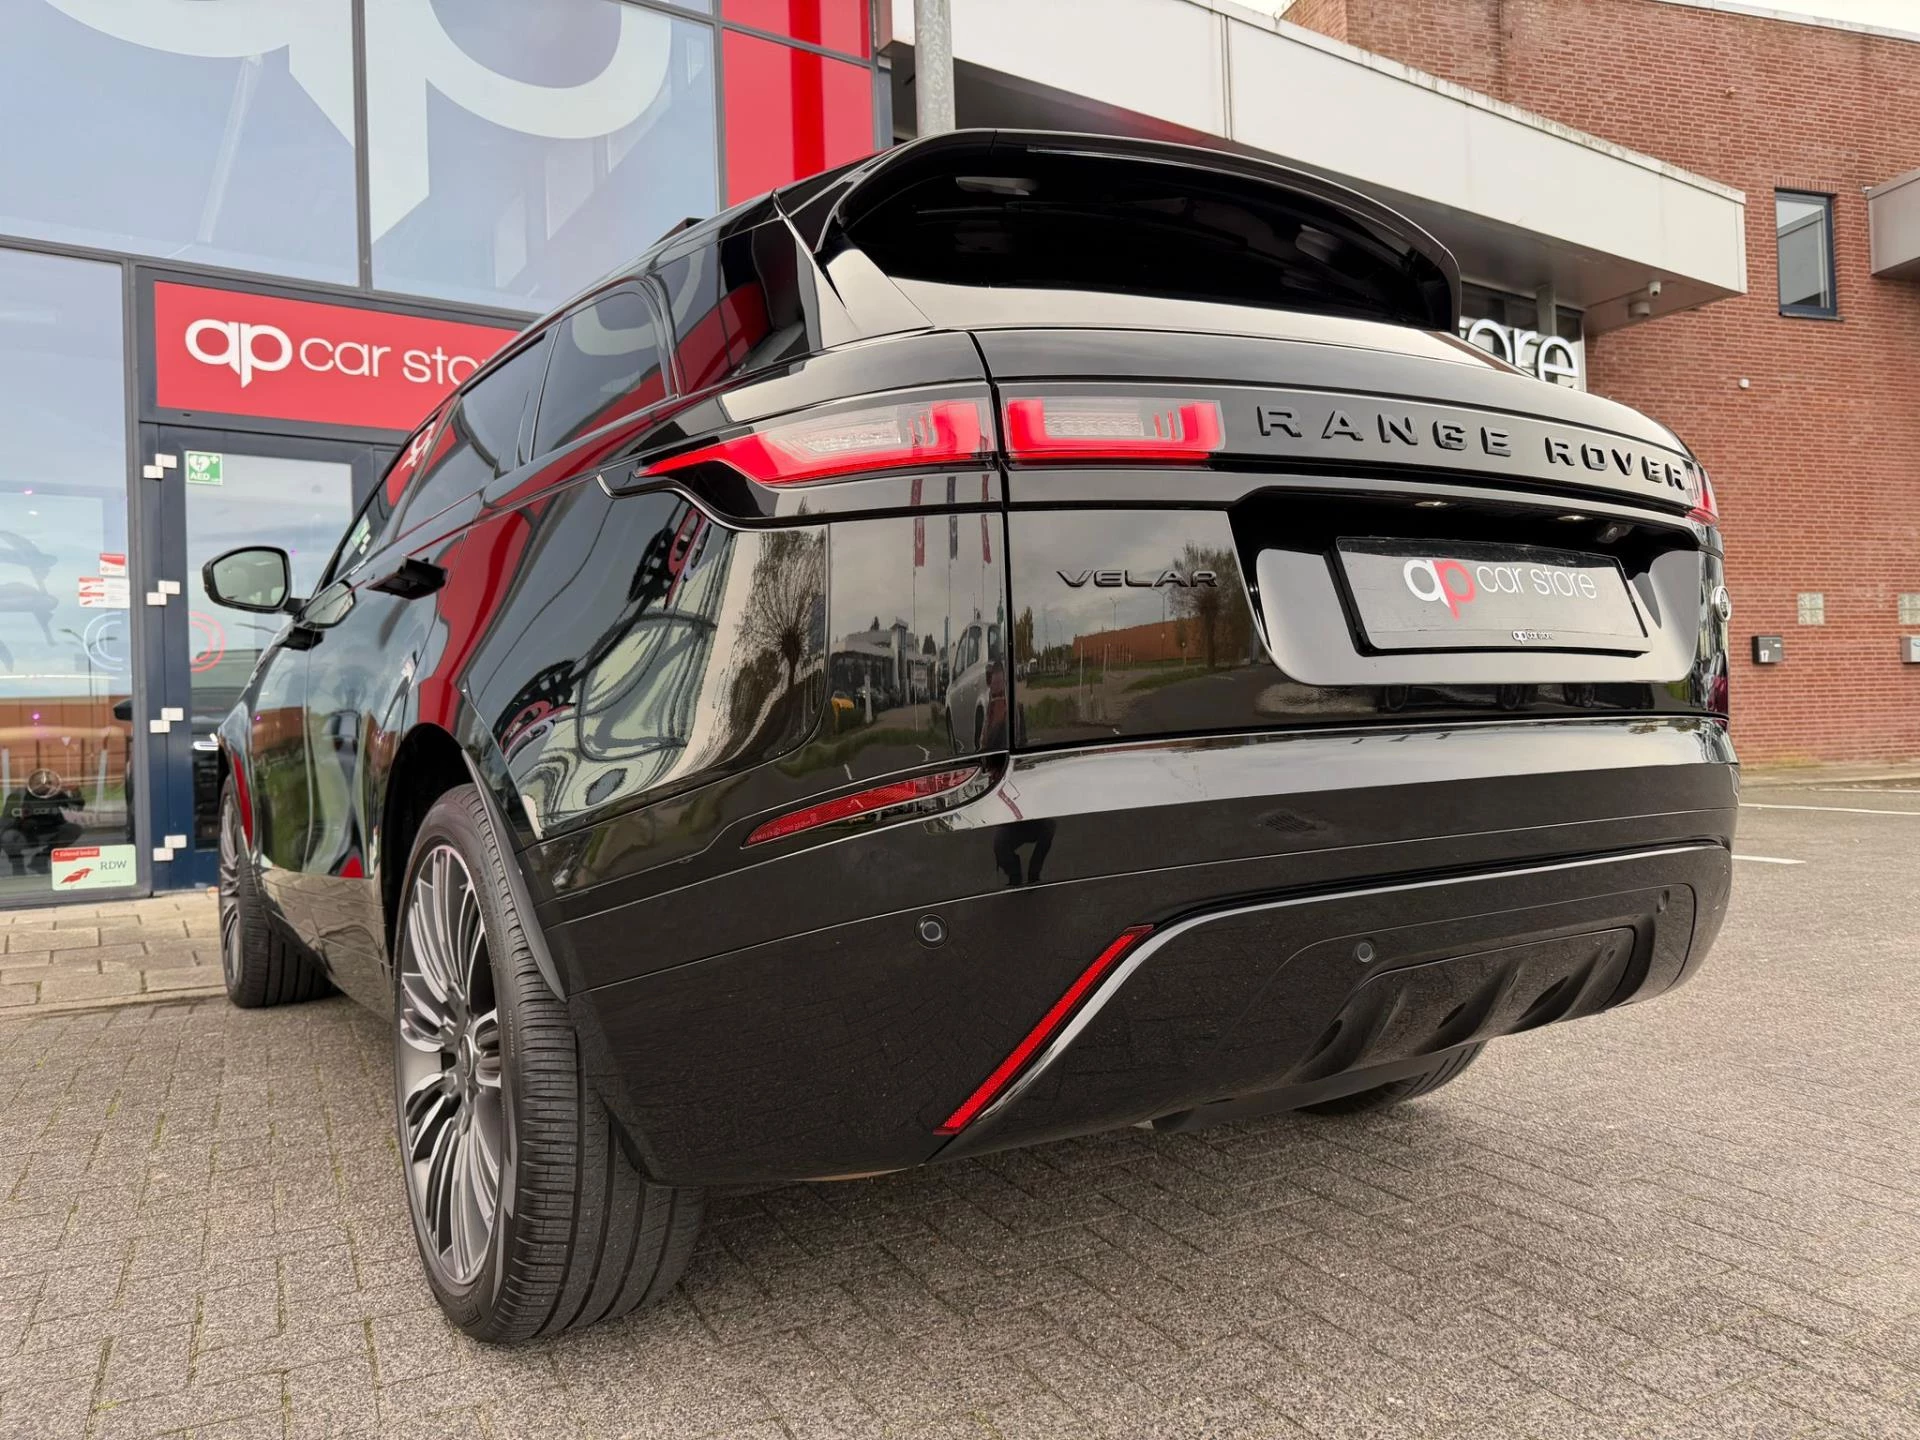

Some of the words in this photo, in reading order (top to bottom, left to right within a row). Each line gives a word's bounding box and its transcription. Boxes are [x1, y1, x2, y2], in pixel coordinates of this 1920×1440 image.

[185, 319, 293, 388] ap
[300, 337, 391, 377] car
[402, 346, 488, 386] sto
[1257, 405, 1512, 457] RANGE
[1545, 436, 1687, 490] ROVER
[190, 471, 210, 481] AED
[1056, 569, 1218, 588] VELAR
[1403, 559, 1476, 621] ap
[1476, 565, 1525, 594] car
[1530, 564, 1598, 599] store
[100, 860, 127, 871] RDW
